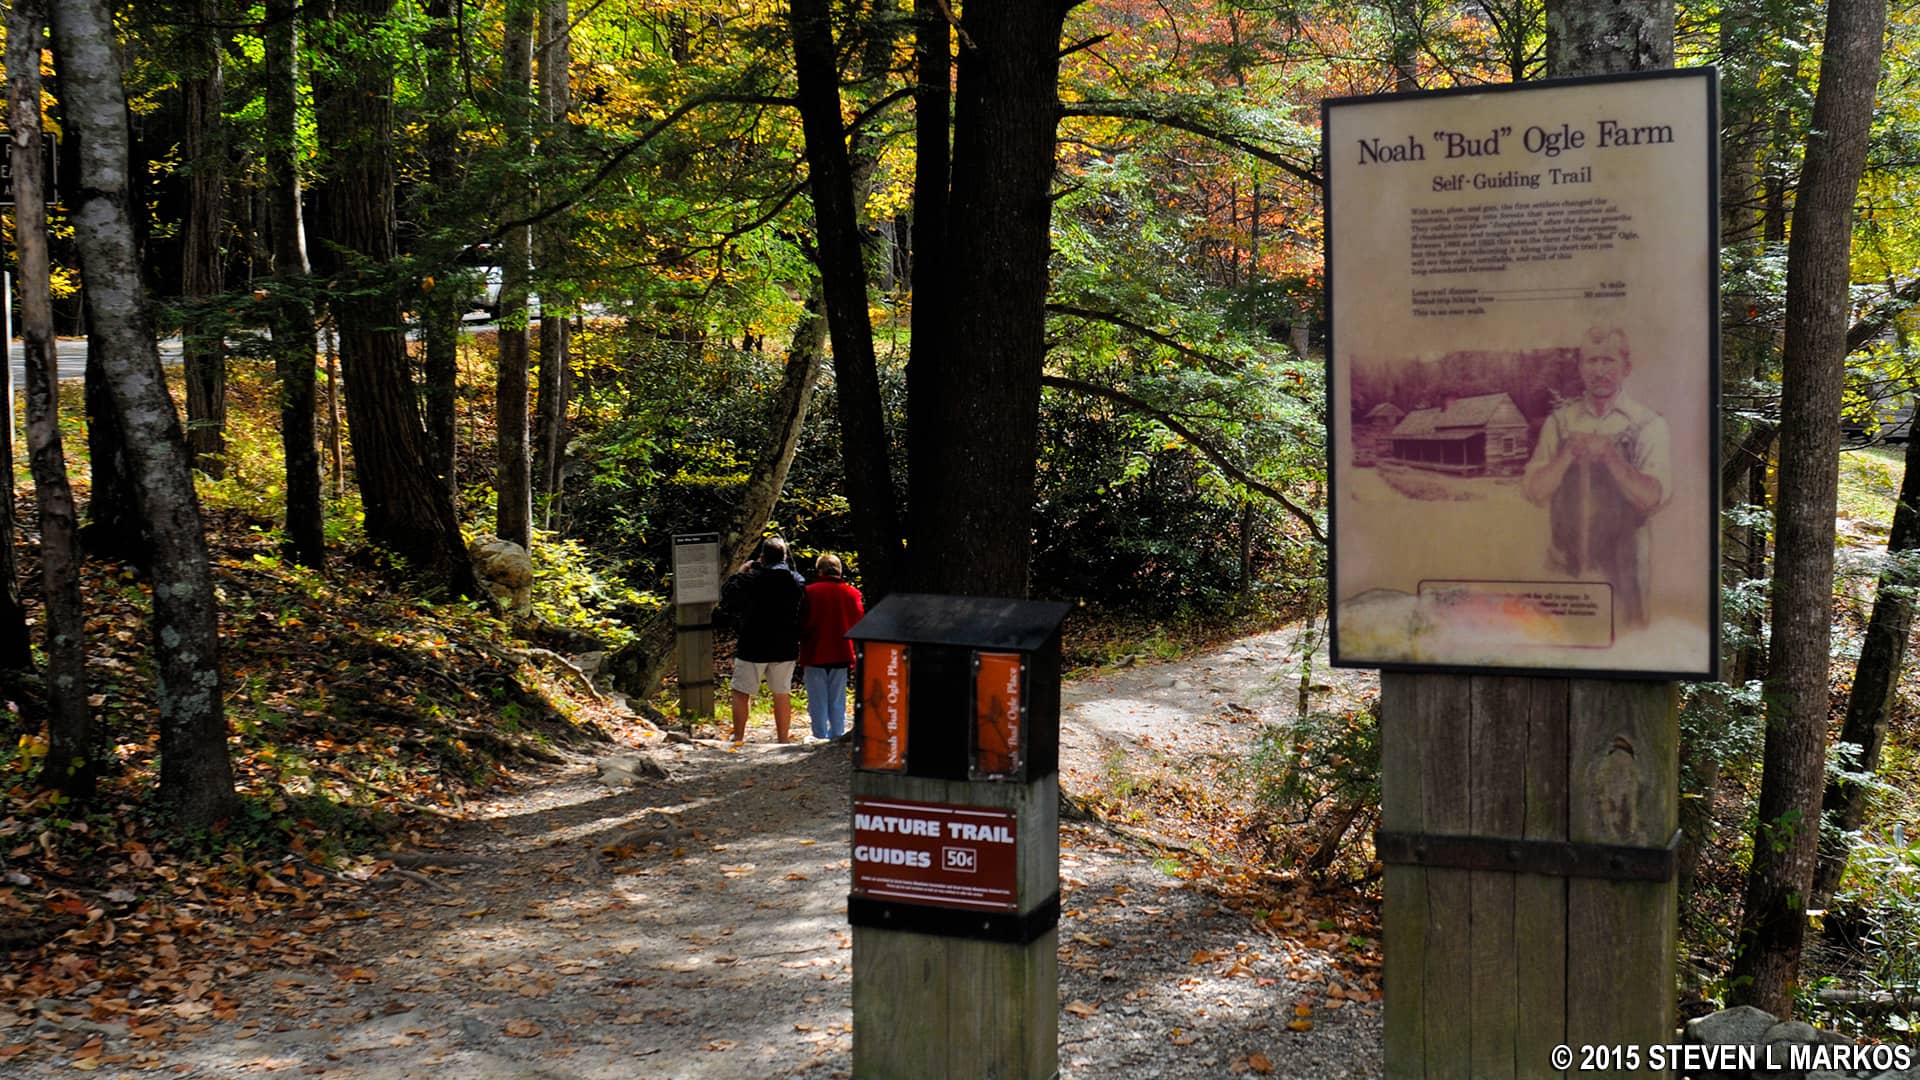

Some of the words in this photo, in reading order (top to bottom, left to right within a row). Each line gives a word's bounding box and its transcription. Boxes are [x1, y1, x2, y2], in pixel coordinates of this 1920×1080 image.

[1357, 136, 1425, 165] Noah
[1433, 127, 1512, 159] “Bud”
[1523, 124, 1585, 157] Ogle
[1596, 120, 1674, 148] Farm
[1432, 170, 1540, 192] Self-Guiding
[1549, 167, 1592, 185] Trail
[888, 649, 897, 676] Place
[888, 682, 900, 703] Ogle
[1007, 668, 1018, 694] Place
[1008, 699, 1019, 720] Ogle
[888, 736, 897, 764] Noah
[854, 814, 941, 838] NATURE
[947, 822, 1014, 843] TRAIL
[854, 846, 931, 868] GUIDES
[947, 851, 973, 867] 50¢
